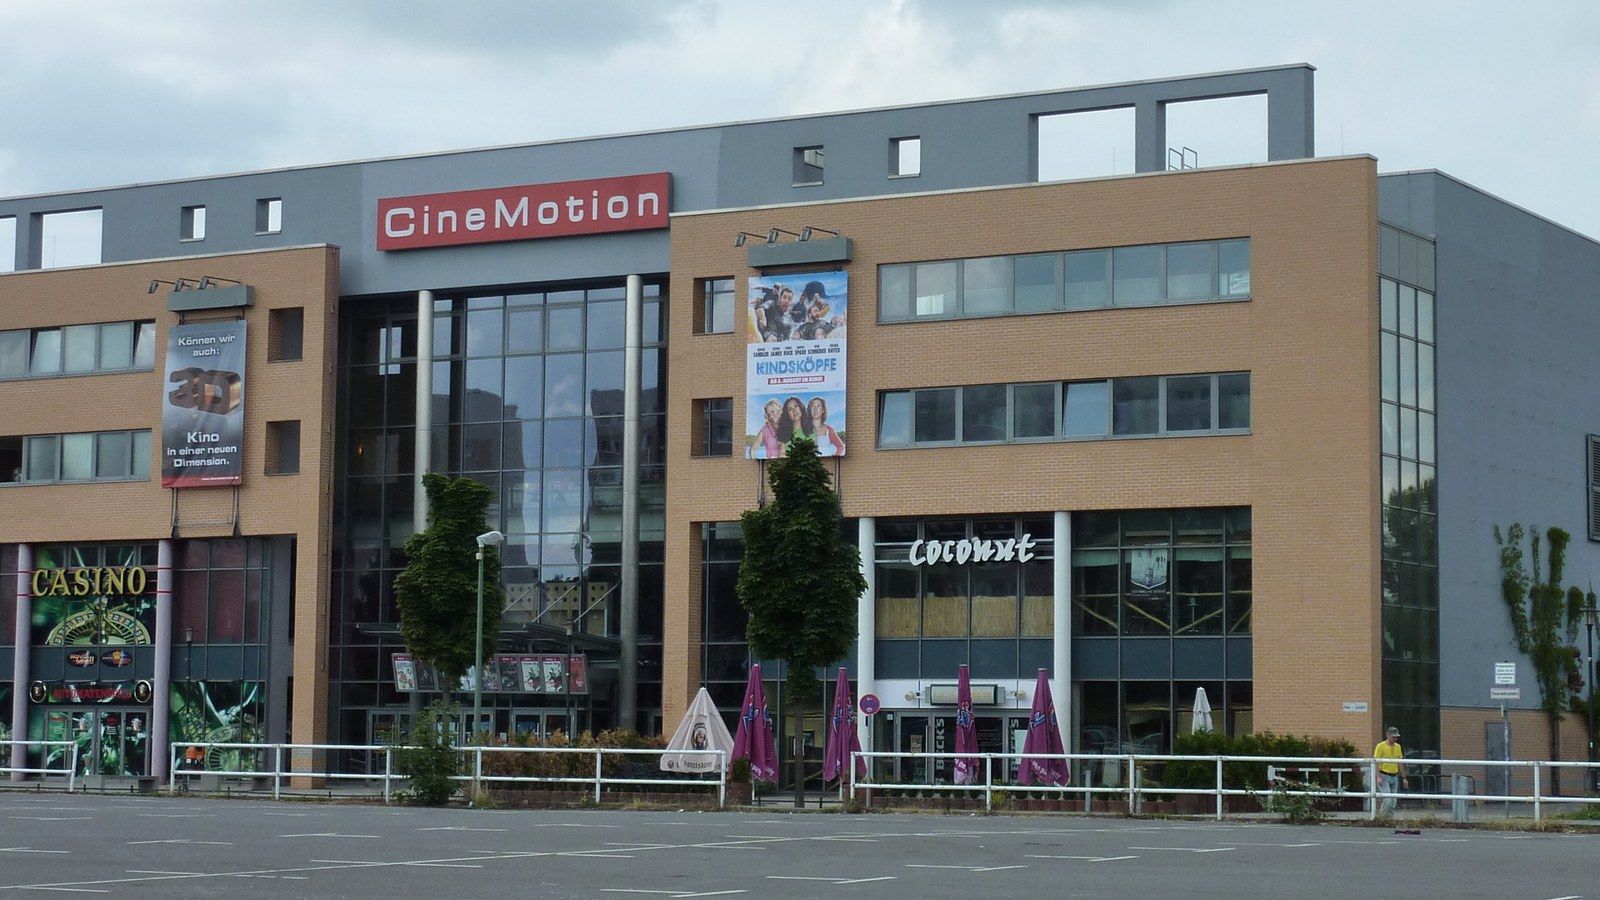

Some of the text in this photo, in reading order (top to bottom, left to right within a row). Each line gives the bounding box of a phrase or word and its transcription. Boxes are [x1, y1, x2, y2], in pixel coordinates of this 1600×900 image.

[385, 190, 659, 238] CineMotion
[178, 334, 236, 346] Können wir
[192, 347, 220, 357] auch:
[756, 356, 837, 375] KINDSKÖPFE
[169, 367, 241, 415] 3D
[187, 431, 220, 443] Kino
[167, 446, 237, 456] in einer neuen
[173, 457, 230, 467] Dimension.
[32, 566, 146, 597] CASINO
